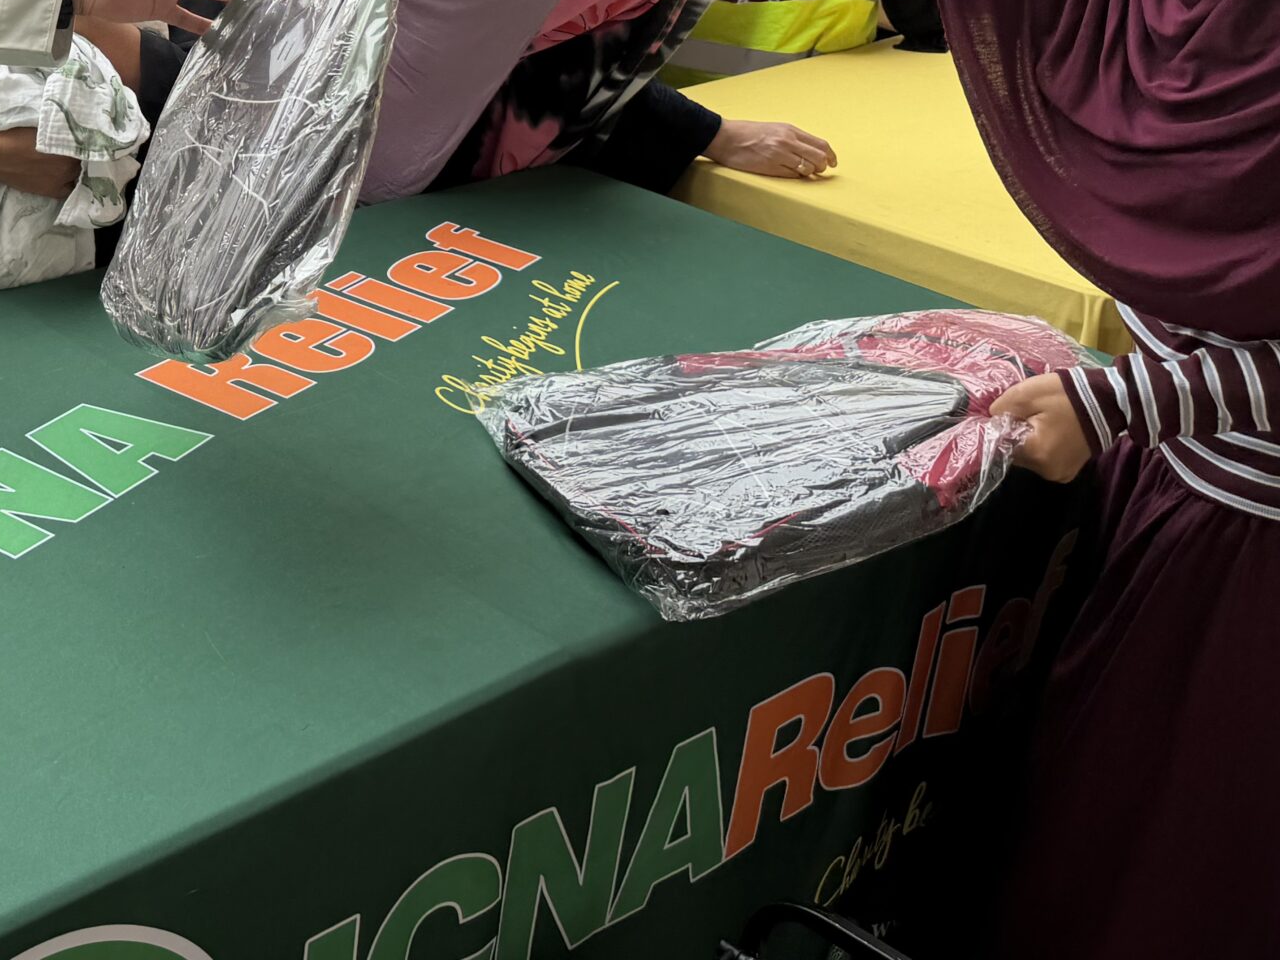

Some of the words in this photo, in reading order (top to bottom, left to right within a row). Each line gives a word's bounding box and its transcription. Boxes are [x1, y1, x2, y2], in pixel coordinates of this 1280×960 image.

[134, 221, 542, 421] Relief
[528, 293, 572, 320] at
[531, 270, 596, 303] home
[303, 726, 725, 960] CNA
